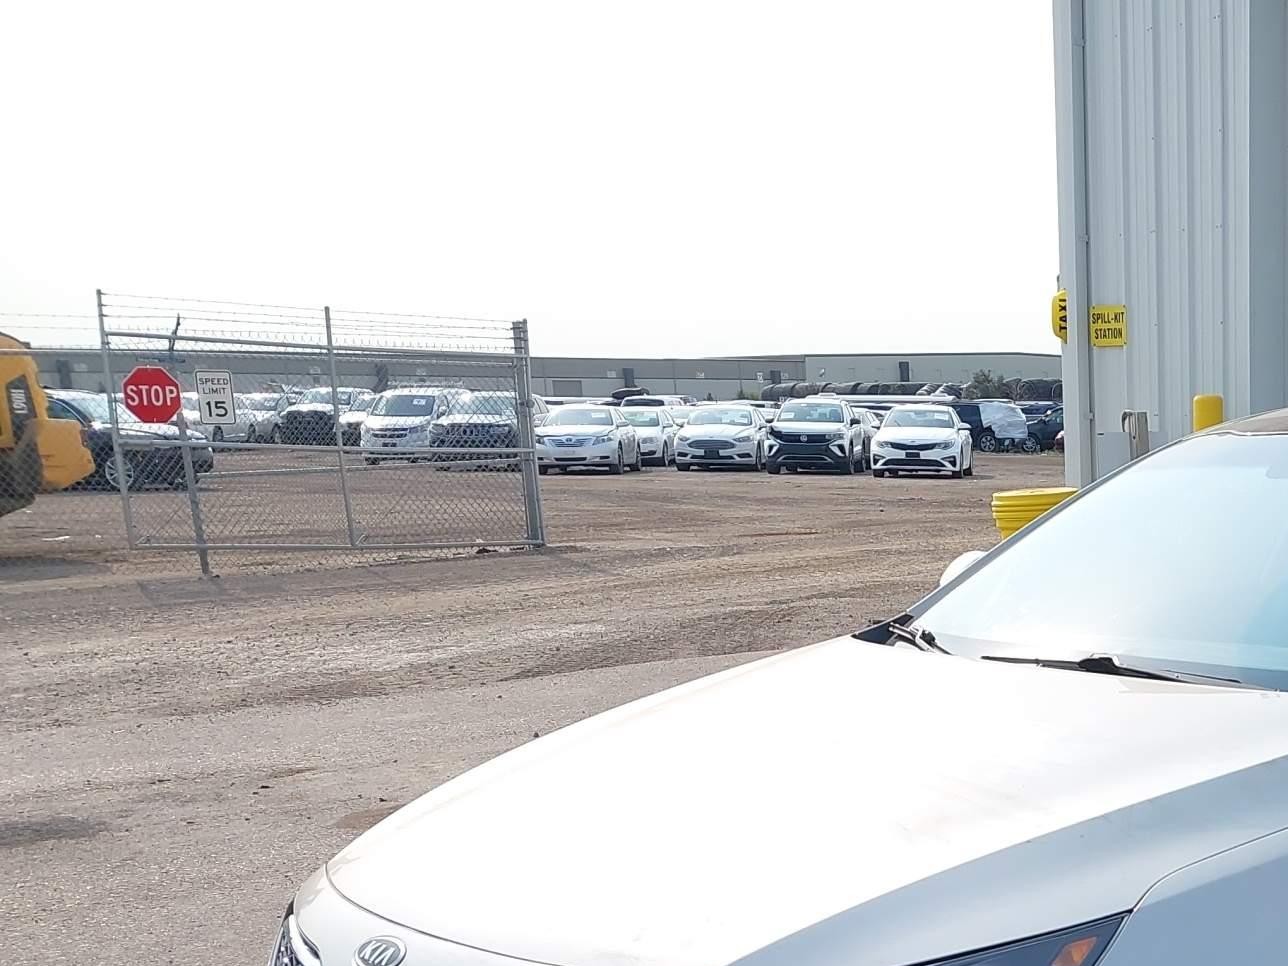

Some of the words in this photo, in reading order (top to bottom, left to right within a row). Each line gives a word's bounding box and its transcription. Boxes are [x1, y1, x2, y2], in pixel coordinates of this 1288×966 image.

[1059, 298, 1068, 333] TAXI
[1091, 312, 1125, 324] SPILL-KIT
[1094, 328, 1123, 339] STATION
[198, 377, 229, 386] SPEED
[126, 385, 177, 407] STOP
[202, 387, 228, 395] LIMIT
[205, 401, 229, 417] 15
[360, 940, 396, 966] KIA
